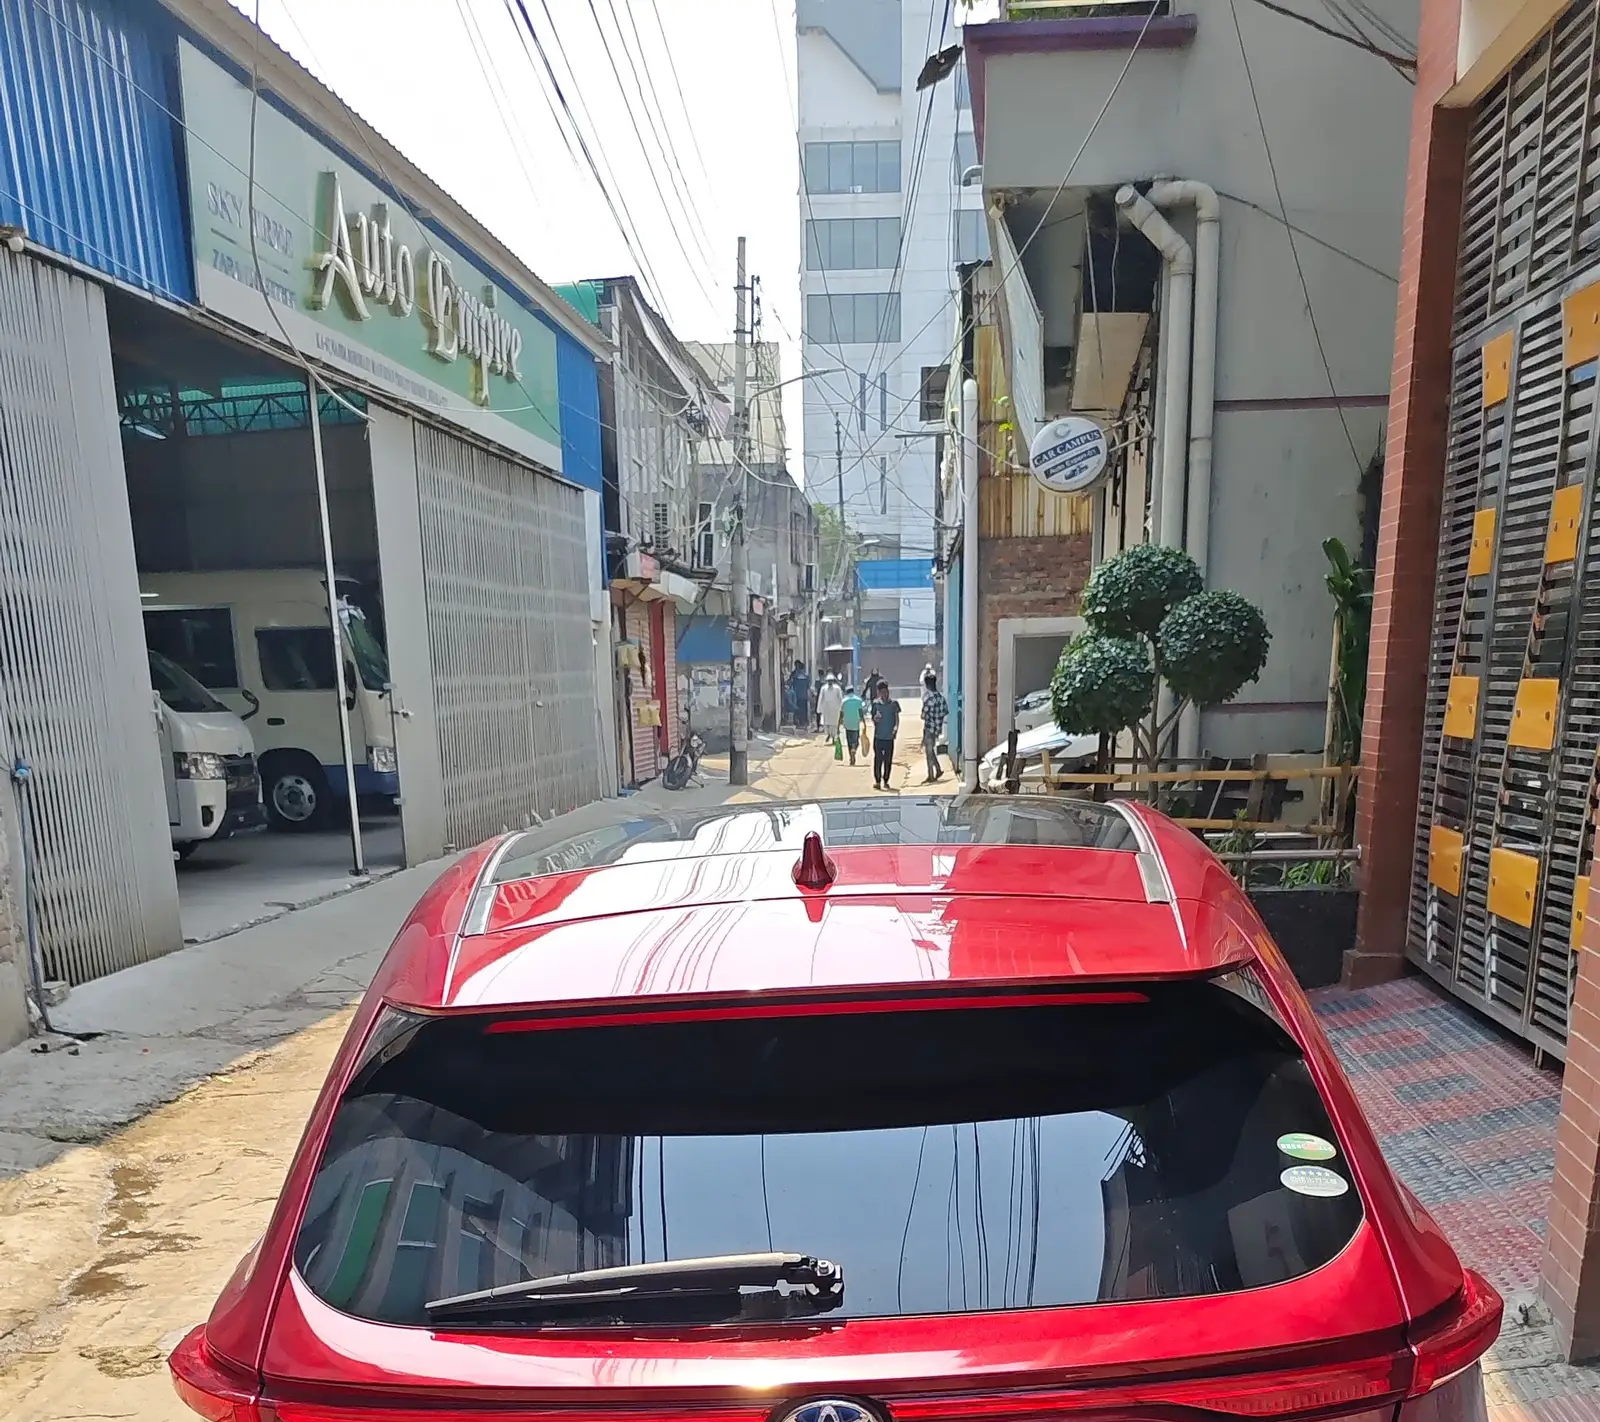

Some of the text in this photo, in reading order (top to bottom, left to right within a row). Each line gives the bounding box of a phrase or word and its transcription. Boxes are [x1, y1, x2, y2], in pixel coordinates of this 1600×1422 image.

[319, 171, 416, 321] Auto
[1033, 430, 1100, 467] CAR CAMPUS
